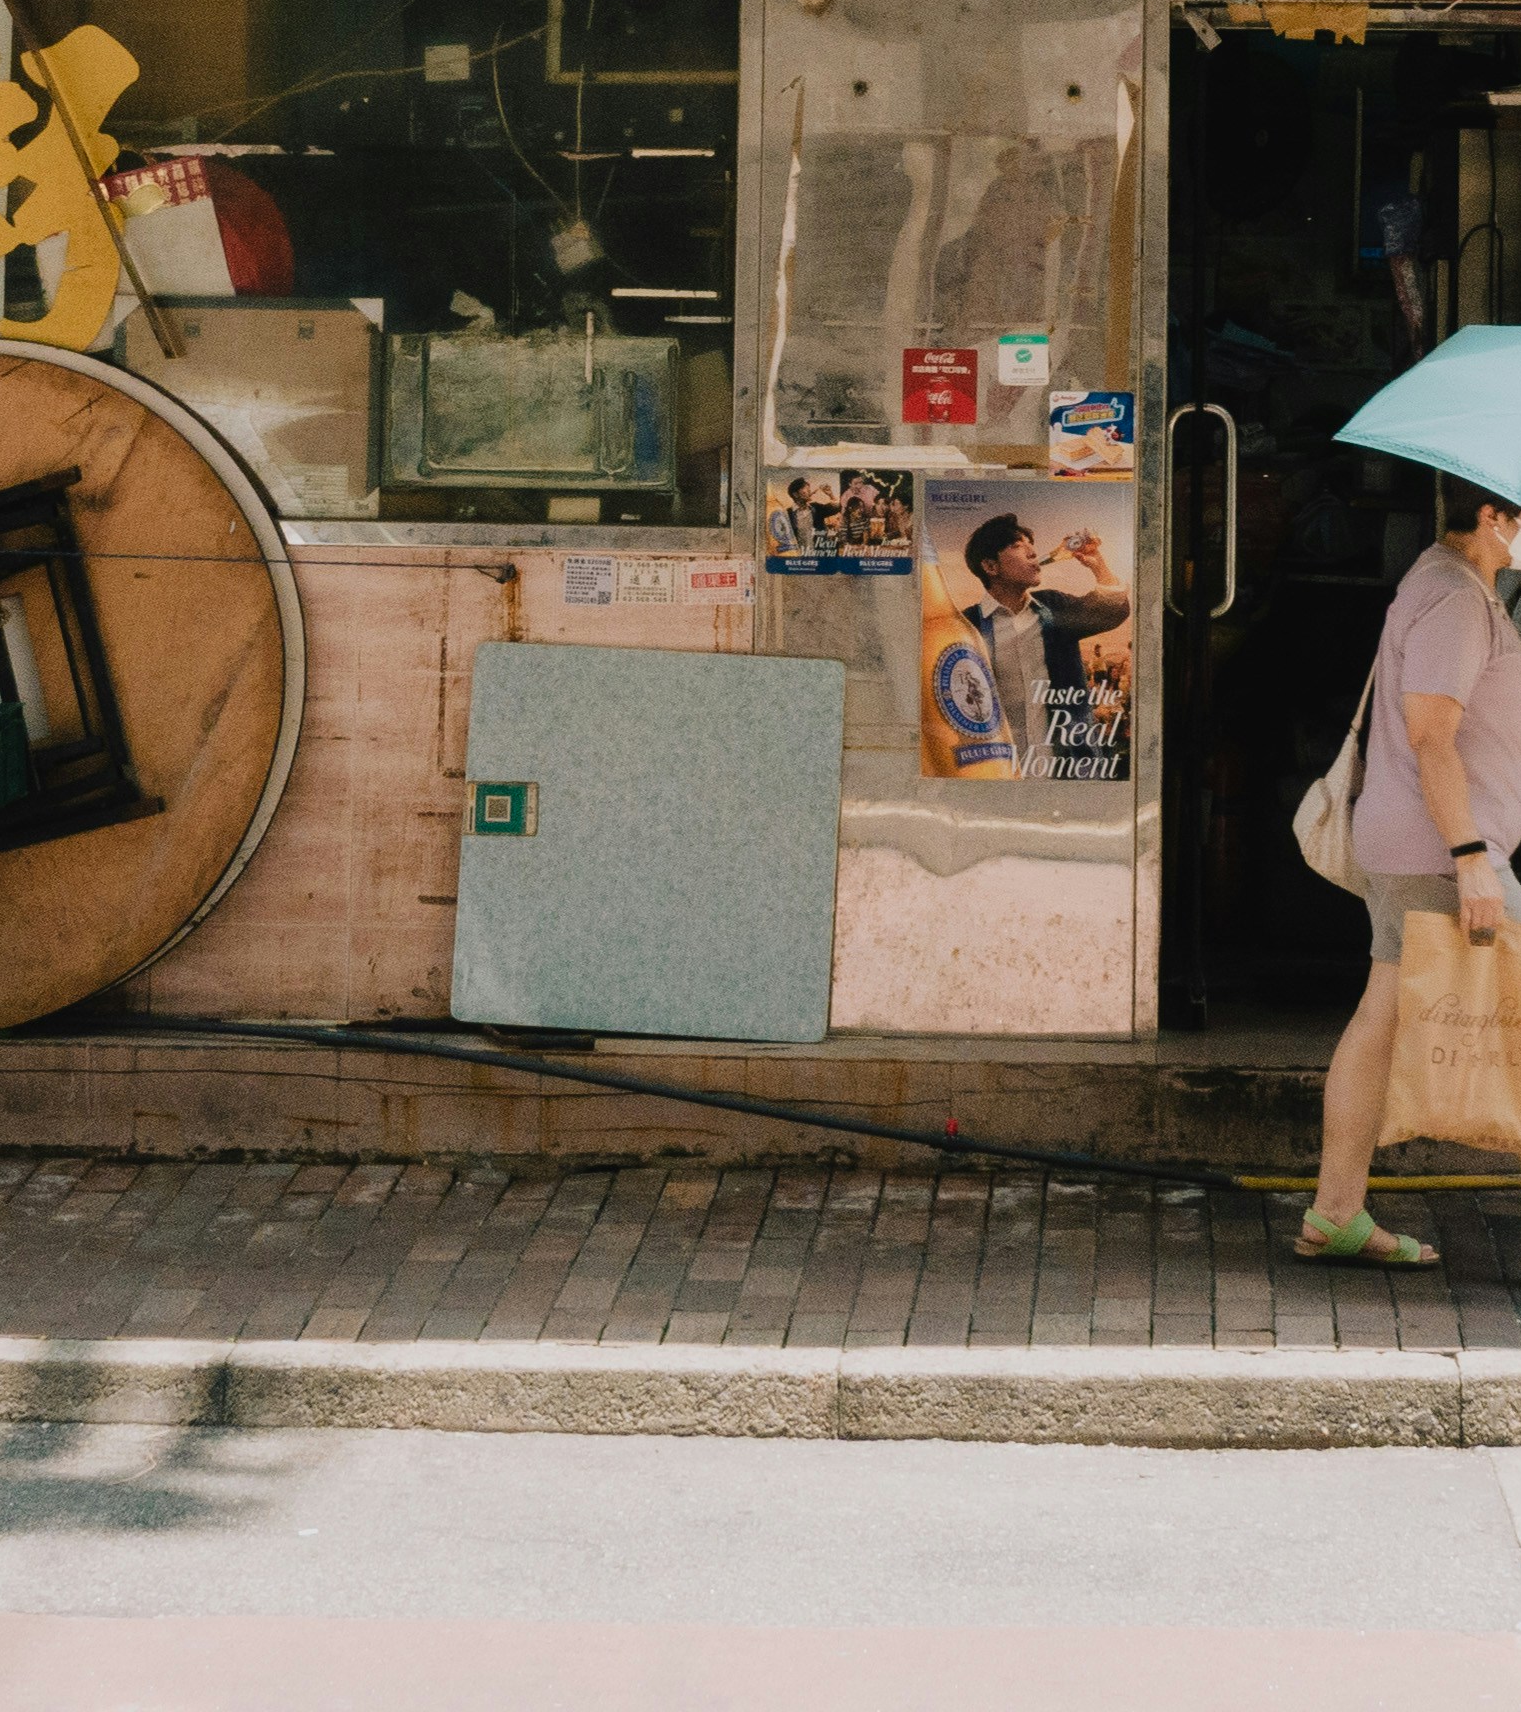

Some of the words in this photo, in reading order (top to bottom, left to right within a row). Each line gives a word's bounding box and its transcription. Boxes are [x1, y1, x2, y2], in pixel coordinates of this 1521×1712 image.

[1030, 679, 1085, 706] Taste
[1087, 678, 1124, 706] the
[1044, 709, 1125, 748] Real
[1011, 744, 1122, 781] Moment
